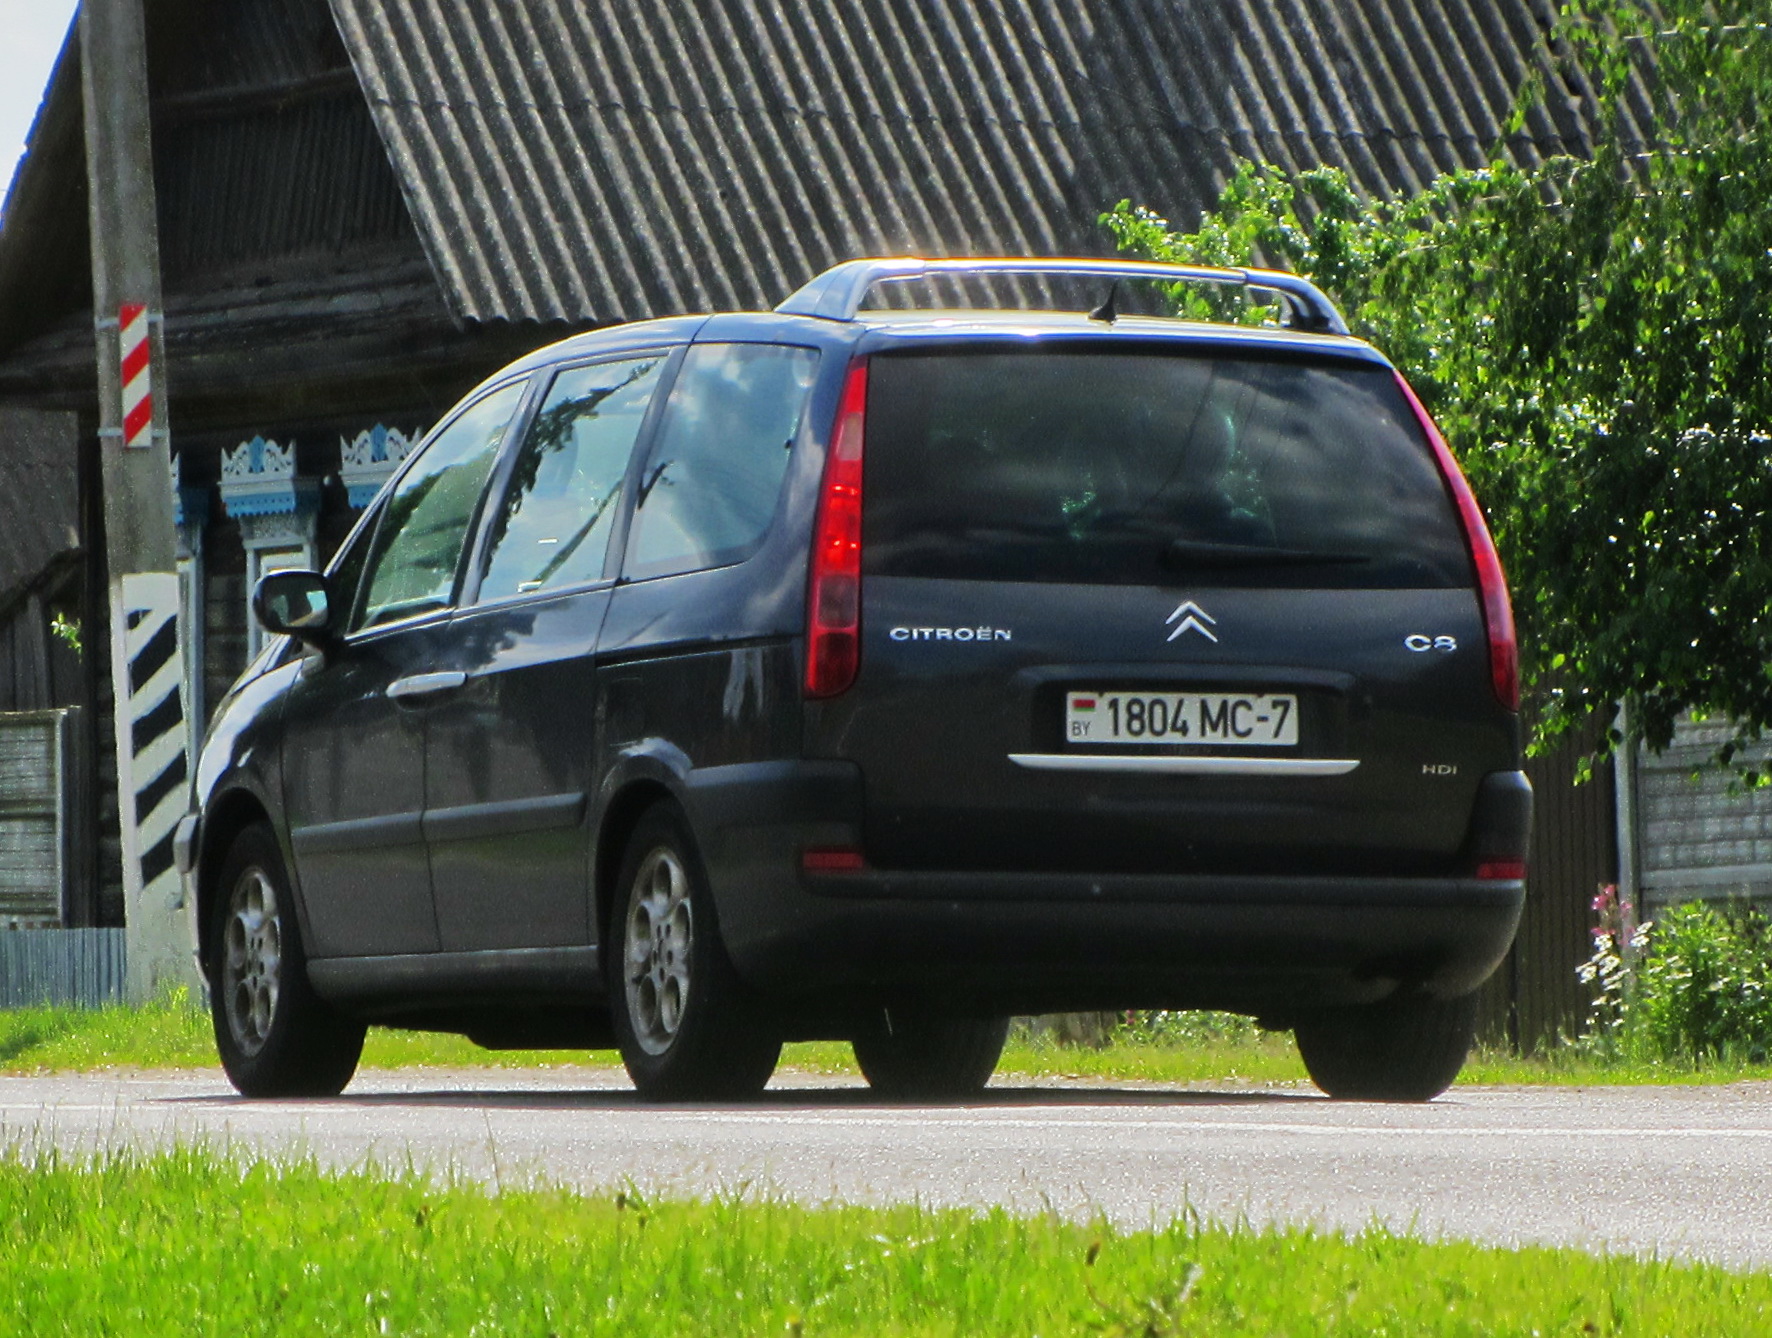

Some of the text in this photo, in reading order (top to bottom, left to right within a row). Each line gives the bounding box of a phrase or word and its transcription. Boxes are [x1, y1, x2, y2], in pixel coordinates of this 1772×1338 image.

[889, 626, 1012, 641] CITROËN
[1404, 634, 1458, 652] C8
[1108, 698, 1291, 738] 1804 MC-7
[1072, 721, 1091, 736] BY
[1422, 764, 1458, 775] HDI
